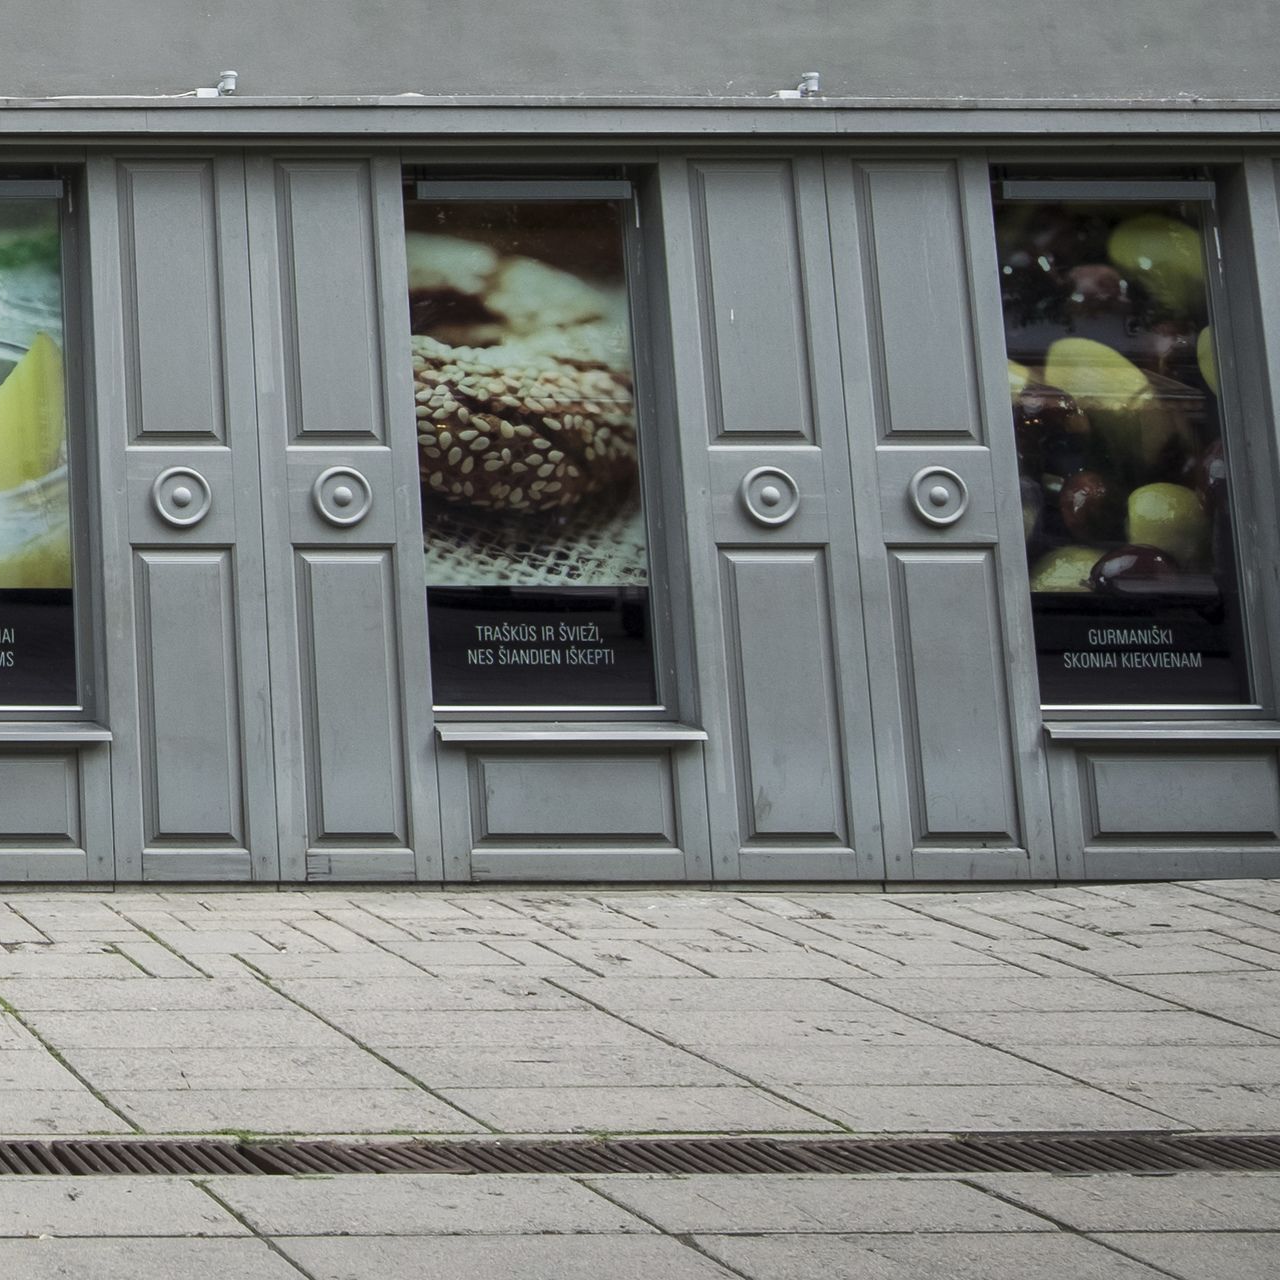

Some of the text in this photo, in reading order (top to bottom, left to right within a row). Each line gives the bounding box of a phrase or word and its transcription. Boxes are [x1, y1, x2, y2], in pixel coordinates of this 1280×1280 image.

[476, 622, 604, 644] TRAŠKŪS IR ŠVIEŽI,
[1088, 626, 1173, 645] GURMANIŠKI
[468, 645, 615, 665] NES ŠIANDIEN IŠKEPTI
[1063, 652, 1202, 669] SKONIAI KIEKVIENAM
